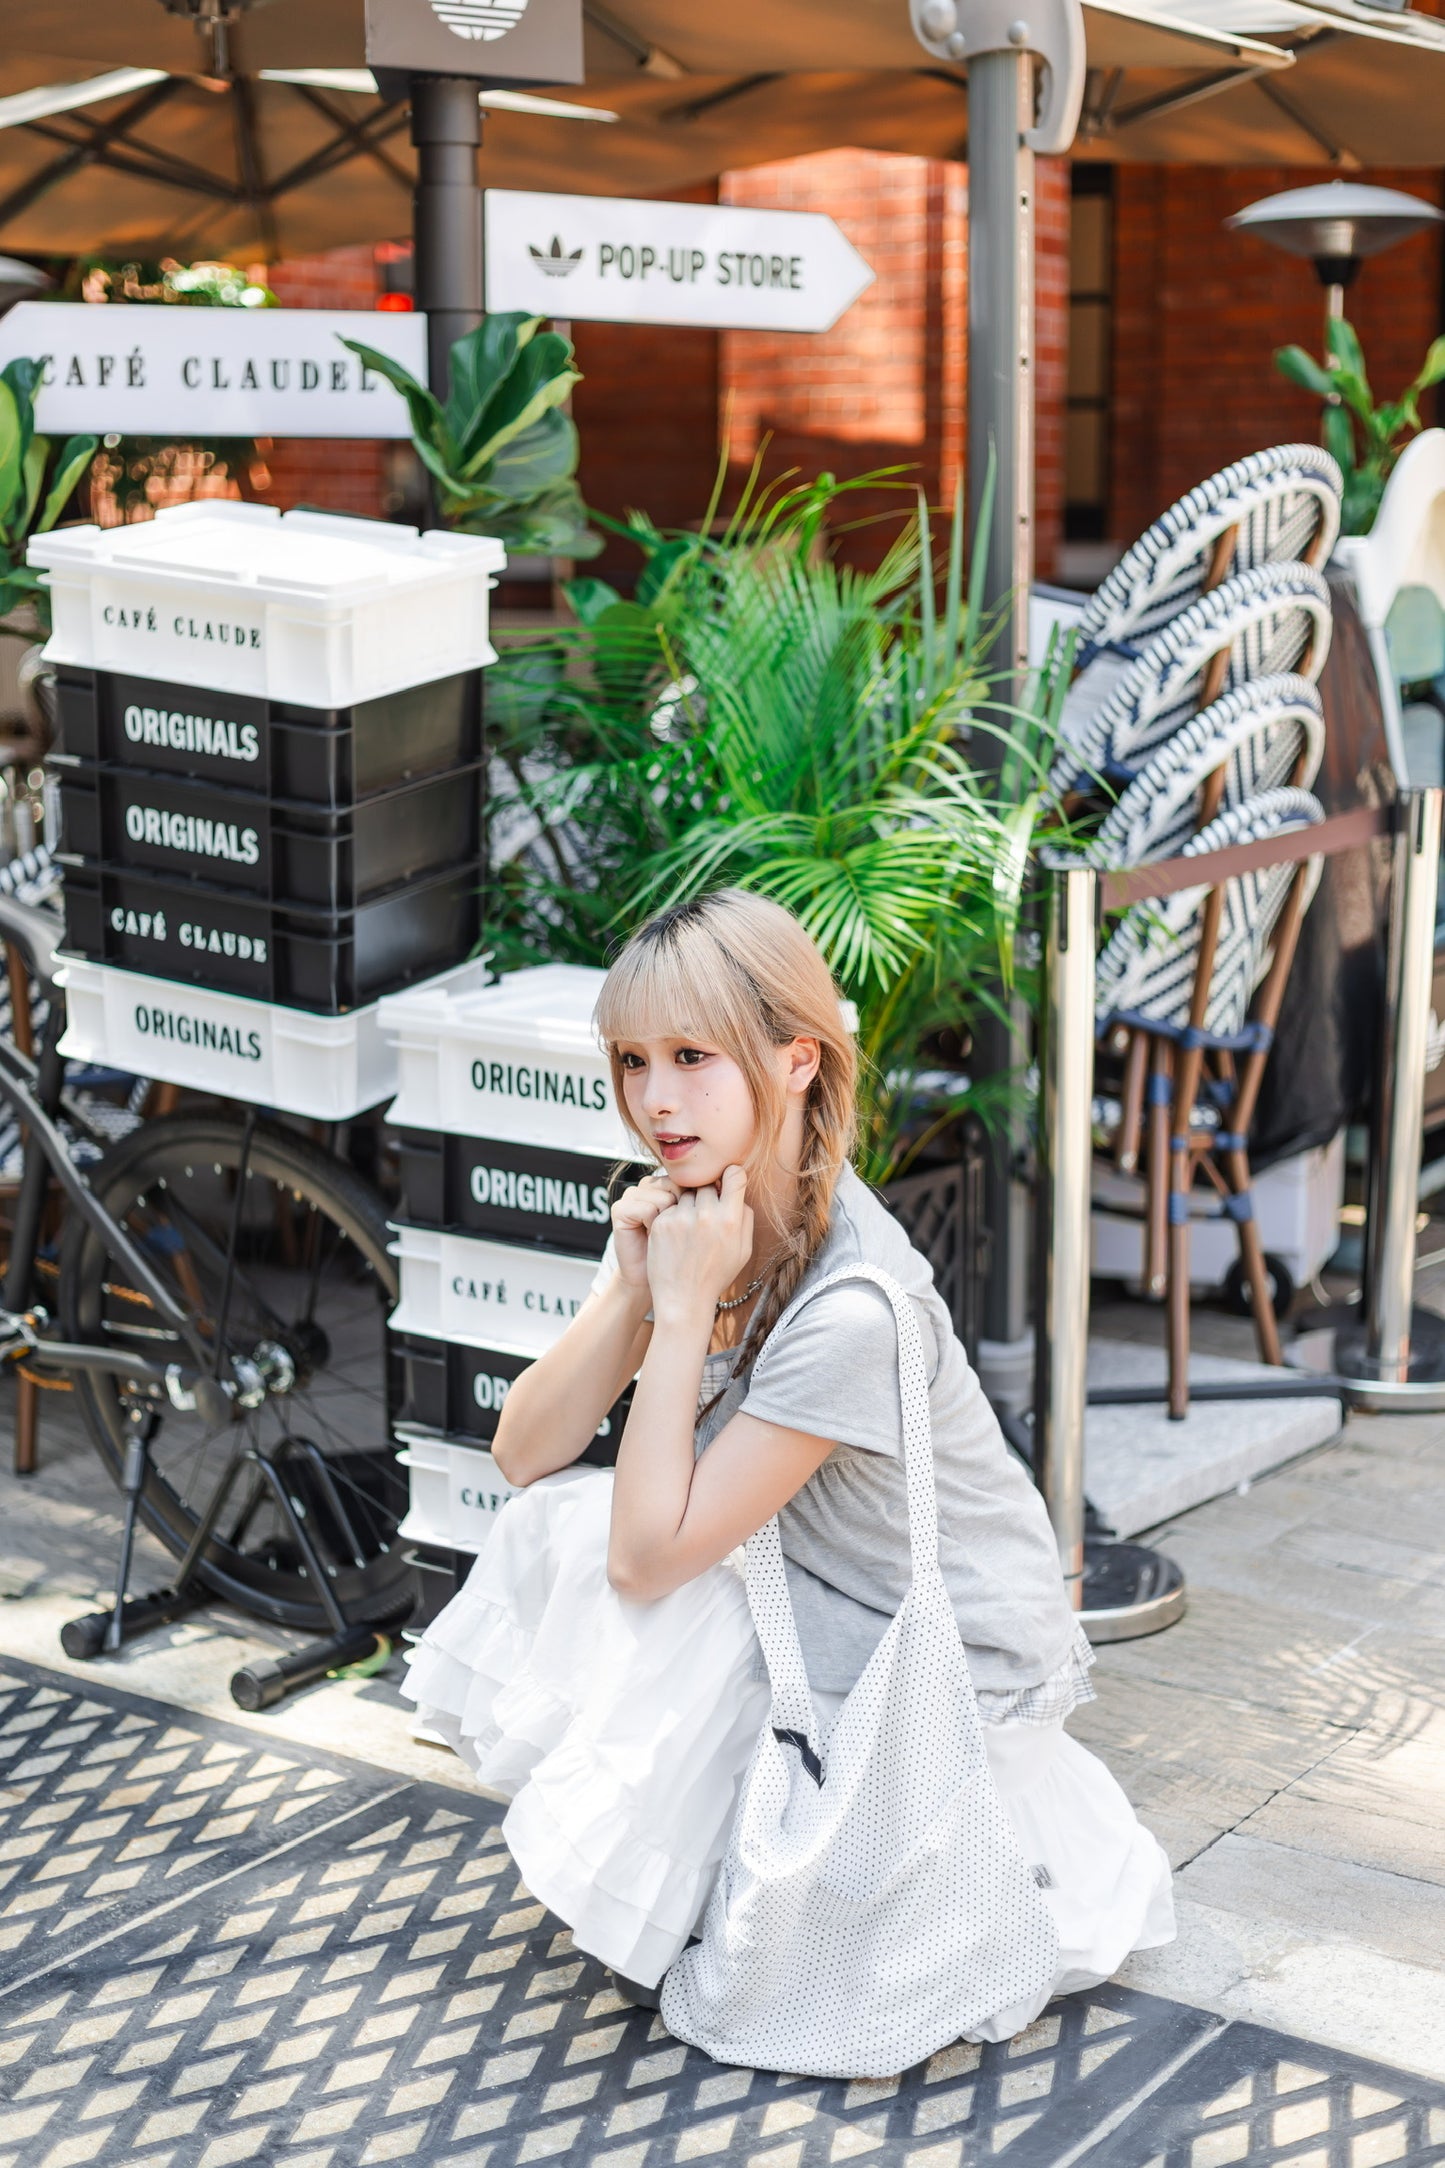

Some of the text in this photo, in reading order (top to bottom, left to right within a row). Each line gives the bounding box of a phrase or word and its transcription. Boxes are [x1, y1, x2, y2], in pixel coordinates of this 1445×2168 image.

[599, 243, 803, 290] POP-UP STORE
[41, 346, 376, 392] CAFÉ CLAUDEL
[103, 605, 261, 649] CAFÉ CLAUDE
[124, 705, 259, 762] ORIGINALS
[126, 804, 260, 865] ORIGINALS
[111, 907, 267, 964] CAFÉ CLAUDE
[135, 1004, 262, 1061] ORIGINALS
[471, 1060, 607, 1111] ORIGINALS
[470, 1165, 610, 1224] ORIGINALS
[452, 1276, 581, 1318] CAFÉ CLAU
